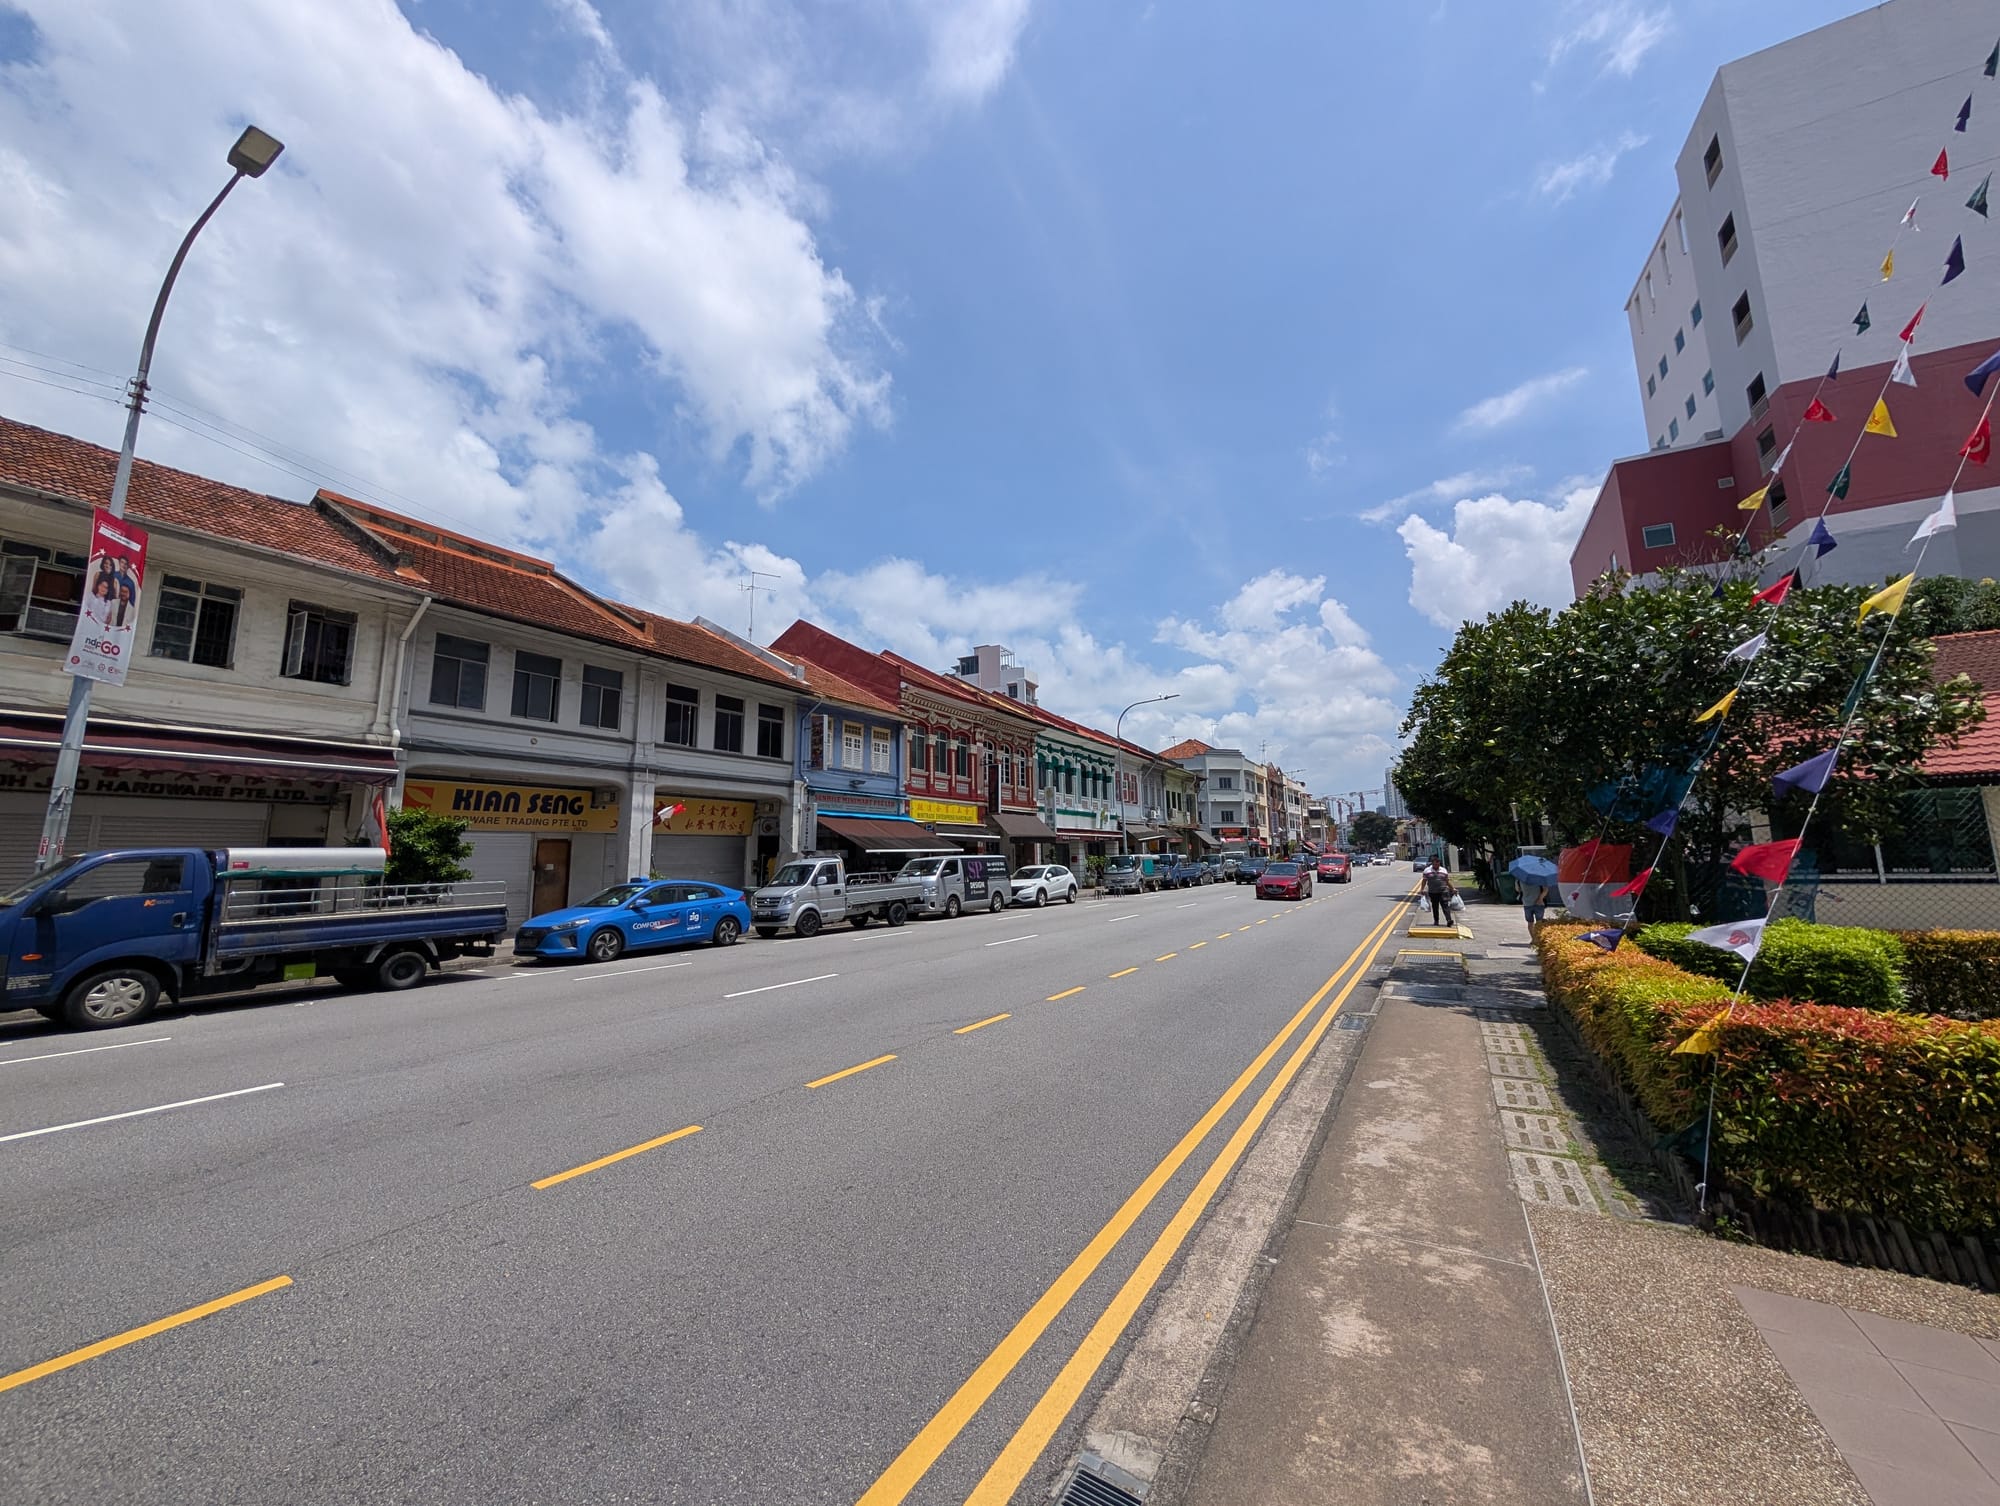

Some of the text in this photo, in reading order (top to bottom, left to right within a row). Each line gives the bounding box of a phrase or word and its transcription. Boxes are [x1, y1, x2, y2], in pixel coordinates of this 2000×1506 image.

[96, 780, 225, 797] HARDWARE
[452, 788, 584, 816] KIAN SENG
[443, 815, 588, 828] RDWARE TRADING PTE LTD
[967, 861, 982, 879] SP
[689, 911, 700, 922] zig
